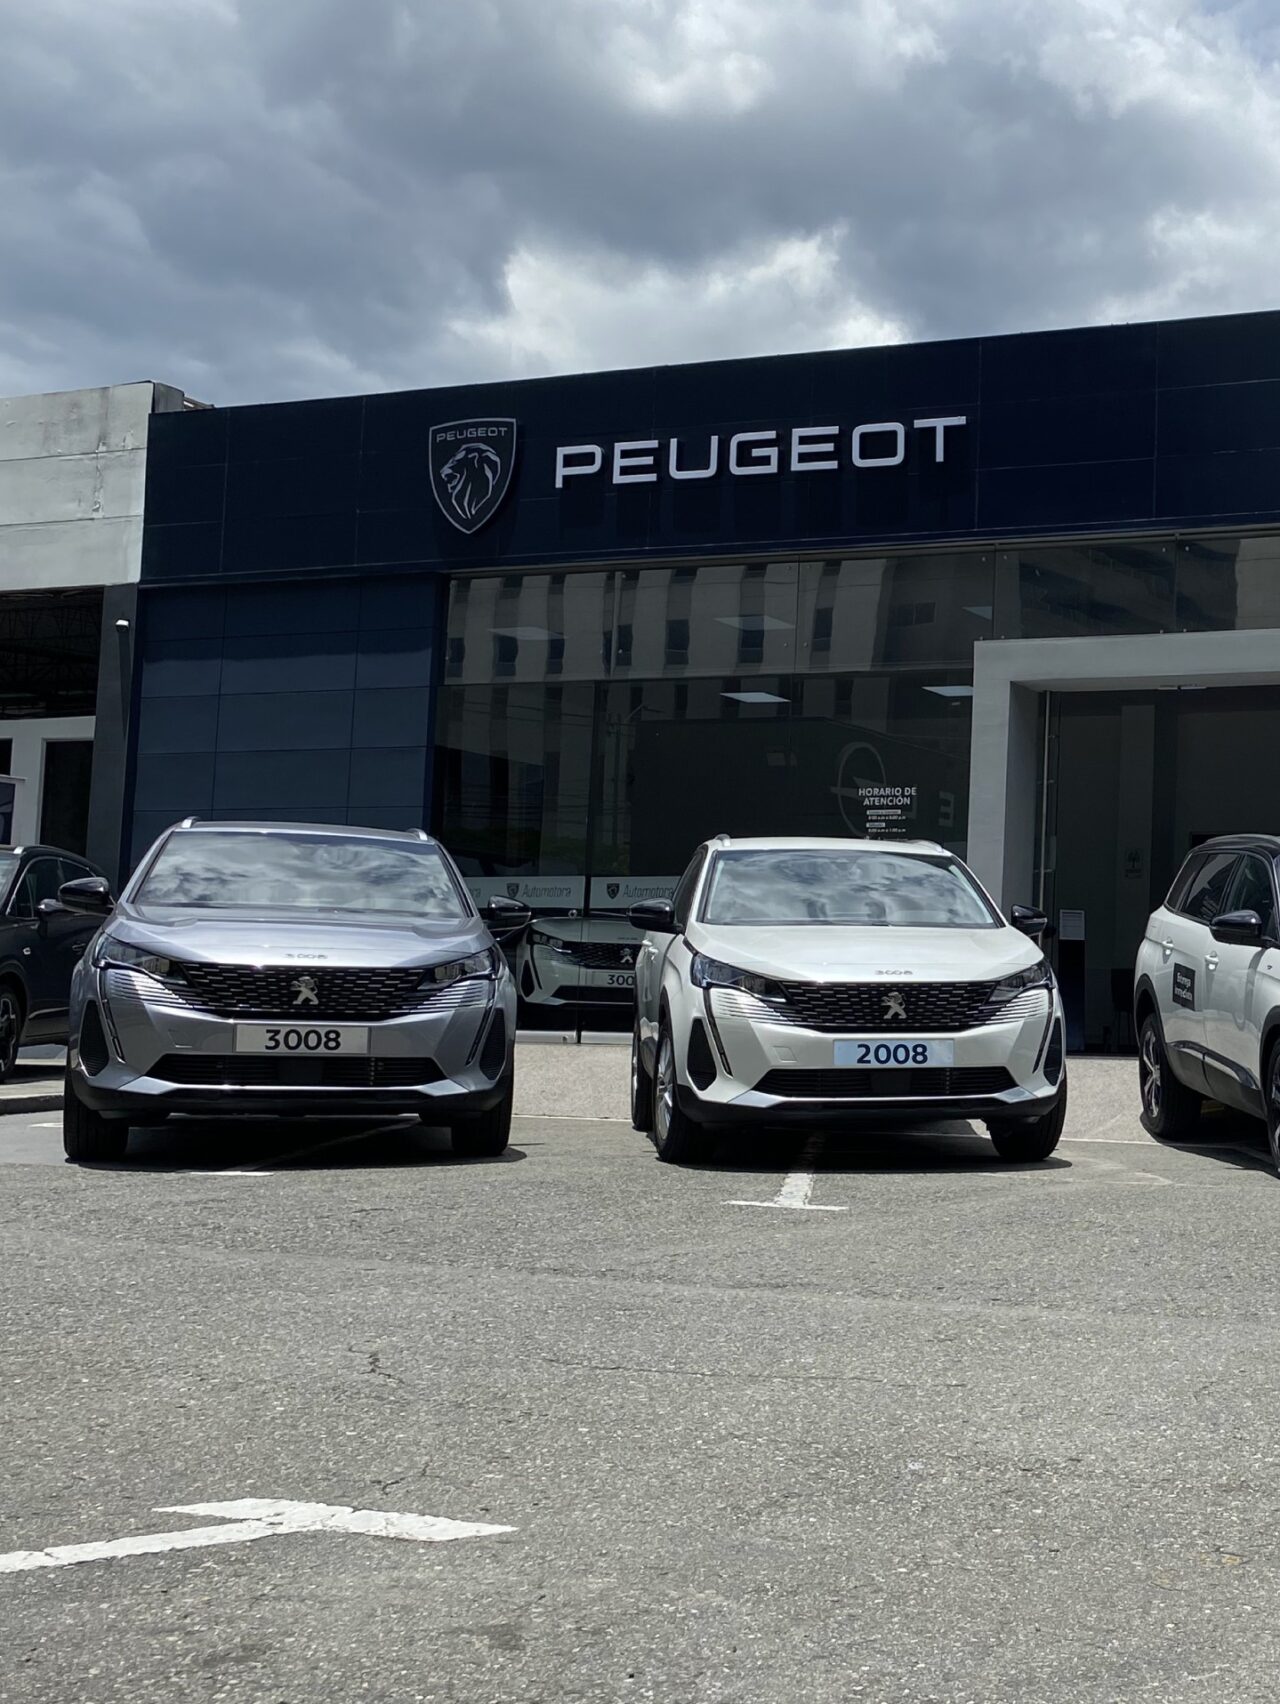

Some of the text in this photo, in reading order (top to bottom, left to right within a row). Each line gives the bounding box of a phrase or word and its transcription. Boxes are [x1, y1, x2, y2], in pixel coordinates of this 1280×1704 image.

[436, 427, 508, 442] PEUGEOT
[554, 415, 967, 489] PEUGEOT
[858, 787, 917, 797] HORARIO DE
[863, 796, 911, 806] ATENCIÓN
[522, 884, 572, 898] Automotora
[606, 974, 634, 986] 300
[264, 1029, 342, 1051] 3008
[856, 1043, 929, 1065] 2008
